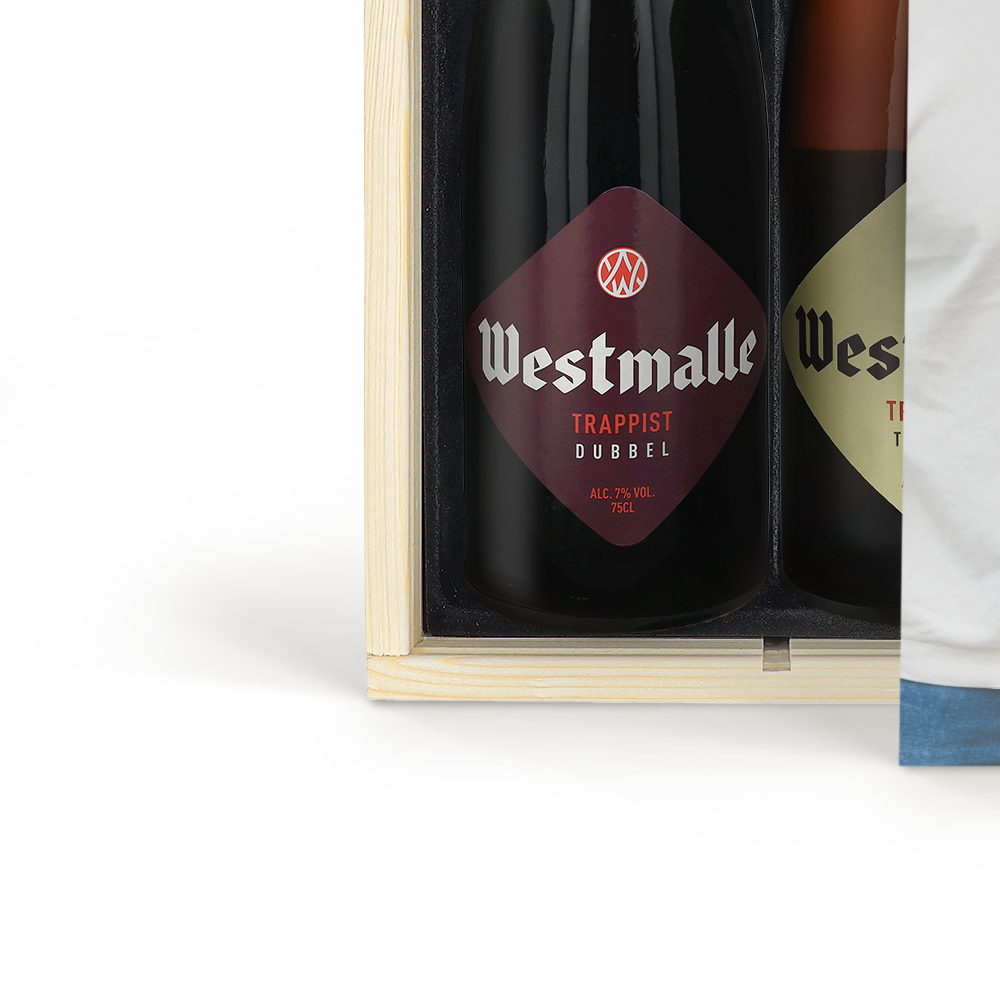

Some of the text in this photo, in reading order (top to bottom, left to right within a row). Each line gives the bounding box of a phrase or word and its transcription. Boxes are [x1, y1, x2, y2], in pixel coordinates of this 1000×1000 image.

[795, 304, 906, 382] Wes
[477, 316, 758, 396] Westmalle
[571, 410, 674, 435] TRAPPIST
[575, 441, 670, 460] DUBBEL
[589, 486, 656, 500] ALC. 7% VOL.
[610, 501, 636, 514] 75CL
